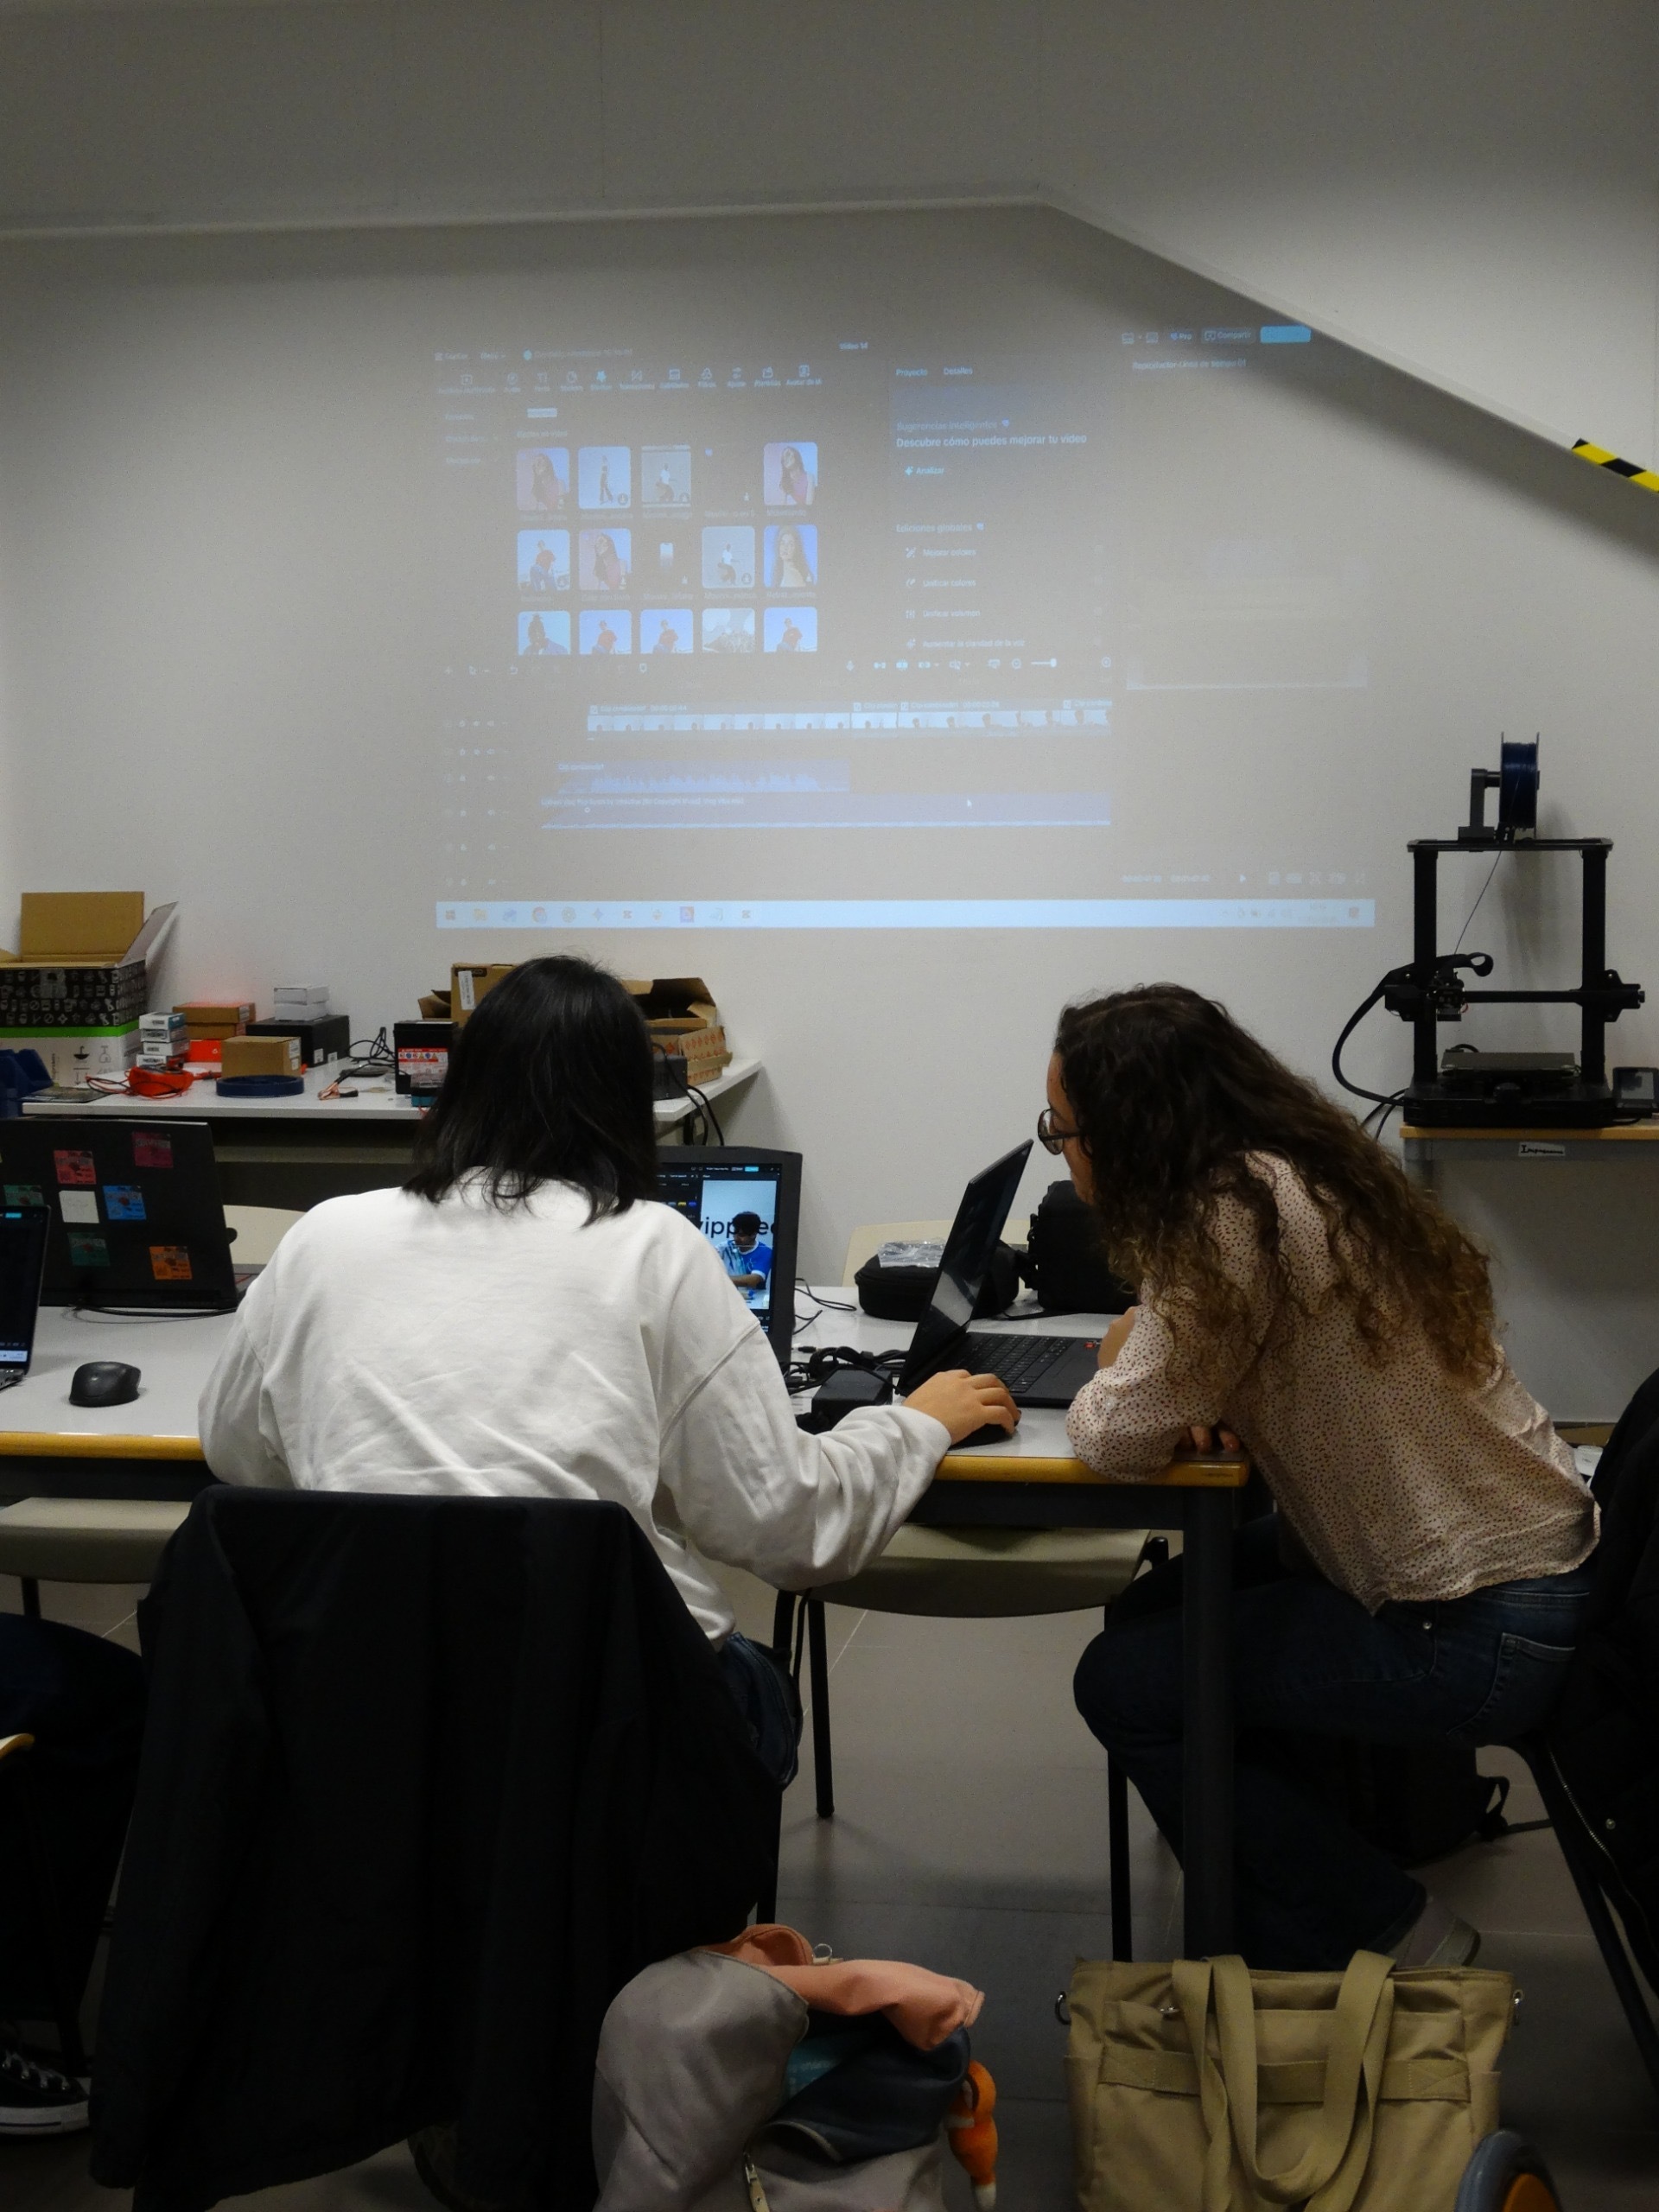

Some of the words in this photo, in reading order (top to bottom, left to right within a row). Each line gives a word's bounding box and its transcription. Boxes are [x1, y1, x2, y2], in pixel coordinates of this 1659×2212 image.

[896, 437, 941, 448] Descubre
[944, 435, 969, 447] cómo
[972, 436, 1007, 448] puedes
[1009, 435, 1046, 447] mejorar
[1048, 435, 1058, 444] tu
